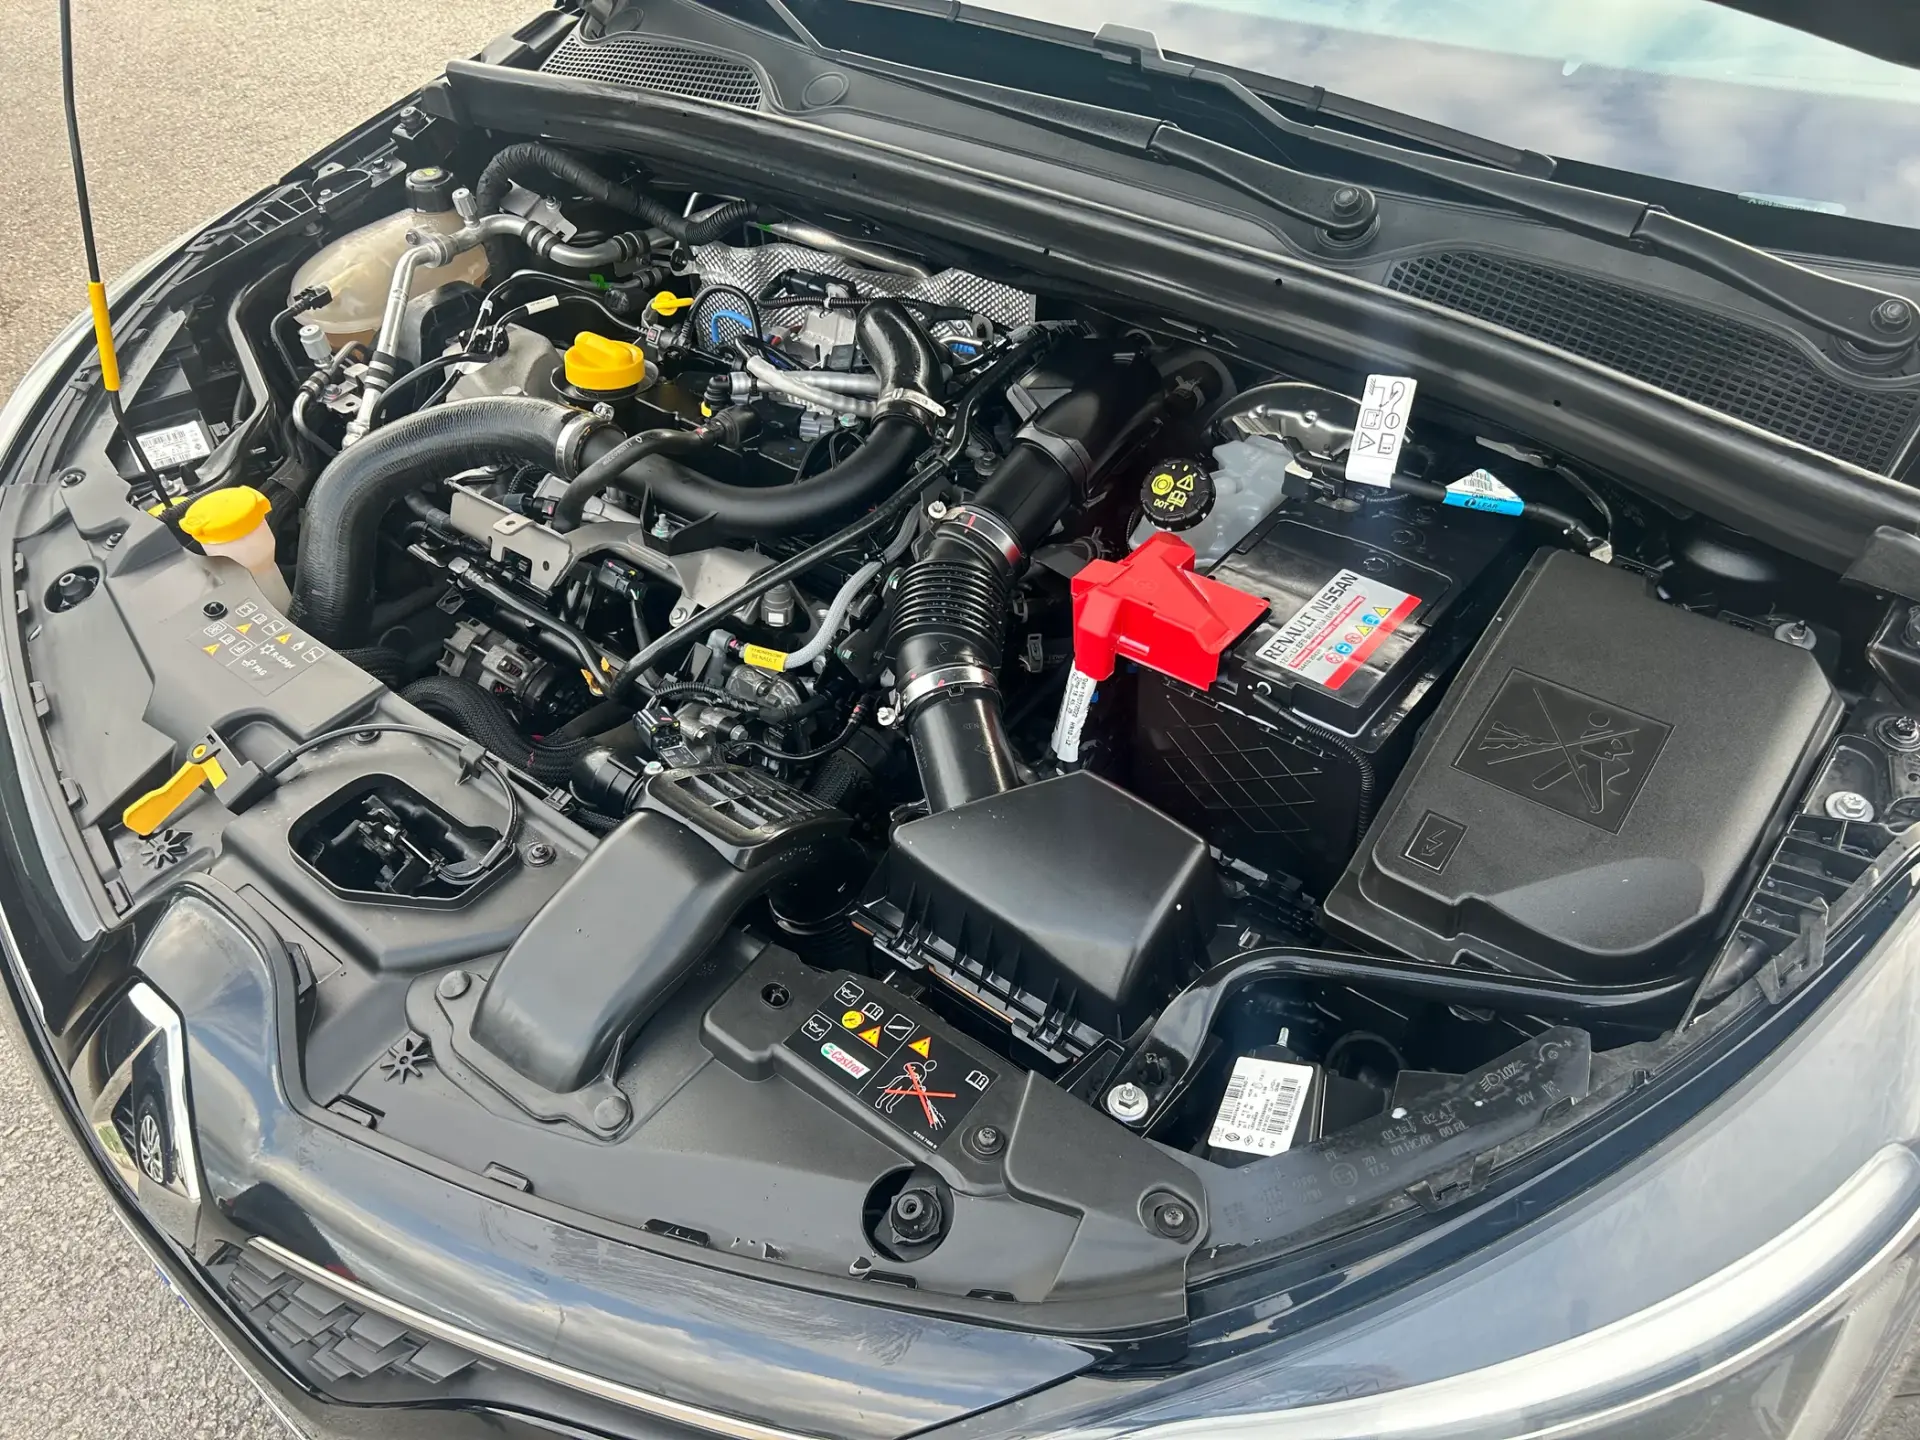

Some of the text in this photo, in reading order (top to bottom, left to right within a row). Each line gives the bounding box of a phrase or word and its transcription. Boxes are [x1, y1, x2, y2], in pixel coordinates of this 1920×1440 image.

[1153, 498, 1175, 512] DOT 4
[1263, 612, 1316, 660] RENAULT
[1311, 573, 1359, 615] NISSAN
[253, 663, 267, 676] PAG
[830, 1047, 865, 1075] Castrol
[1515, 1091, 1535, 1106] 12V
